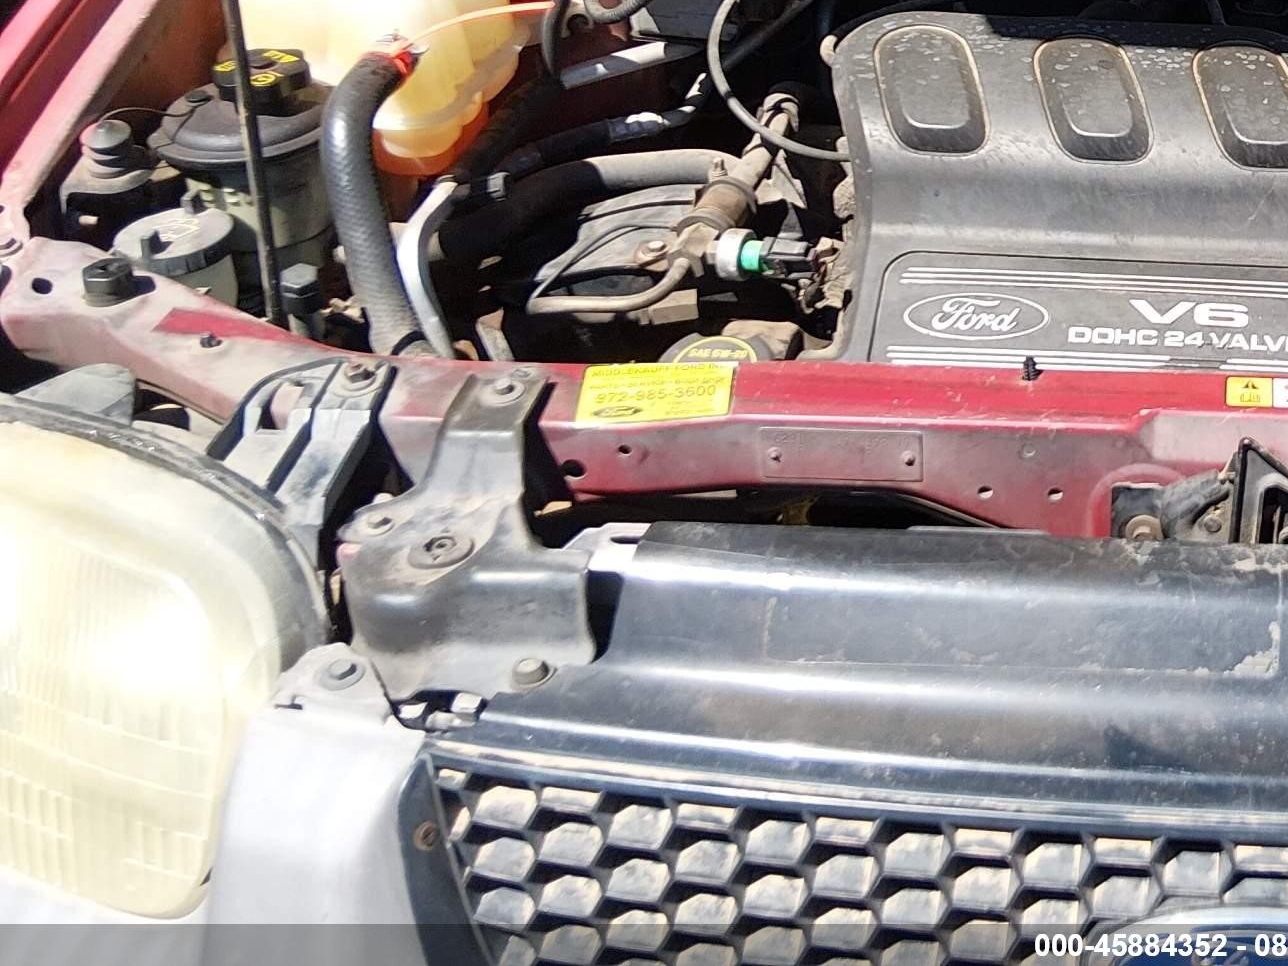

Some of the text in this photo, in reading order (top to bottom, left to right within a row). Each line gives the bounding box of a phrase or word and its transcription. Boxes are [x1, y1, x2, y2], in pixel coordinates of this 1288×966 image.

[931, 296, 1021, 333] Ford
[1129, 298, 1249, 328] V6
[1067, 325, 1158, 347] DOHC
[1164, 329, 1204, 348] 24
